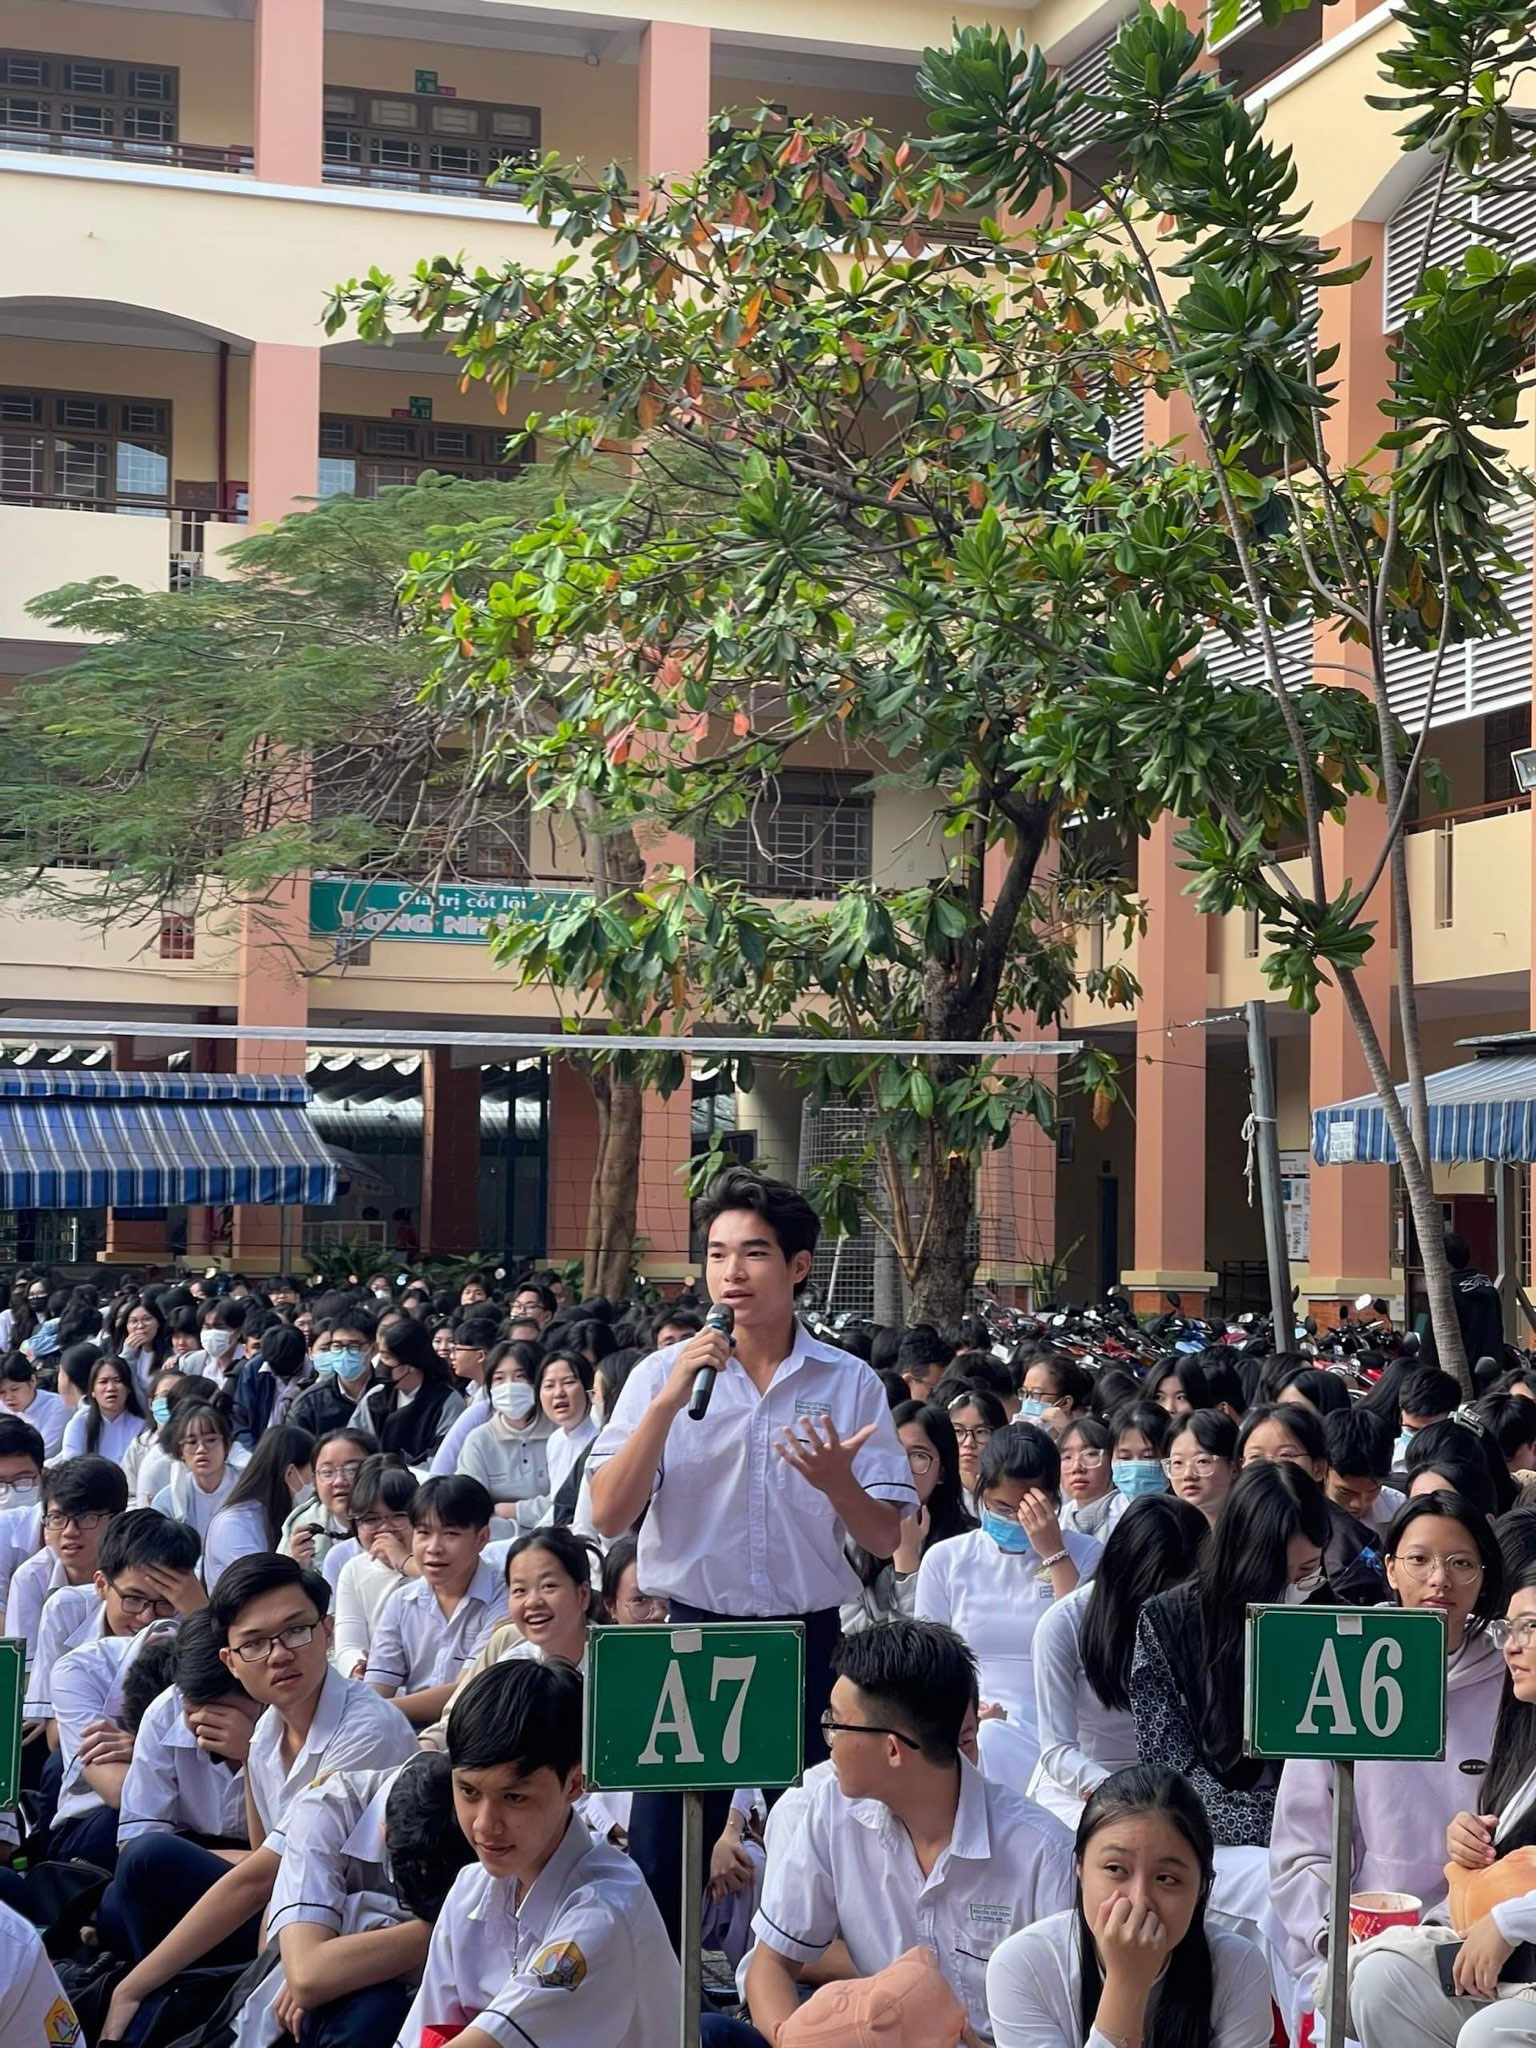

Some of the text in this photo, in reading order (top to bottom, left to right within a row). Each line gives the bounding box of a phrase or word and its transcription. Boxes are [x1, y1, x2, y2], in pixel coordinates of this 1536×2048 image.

[438, 893, 460, 911] trị
[466, 891, 496, 909] cốt
[502, 894, 527, 910] lõi
[638, 1655, 757, 1765] A7
[1295, 1636, 1404, 1738] A6
